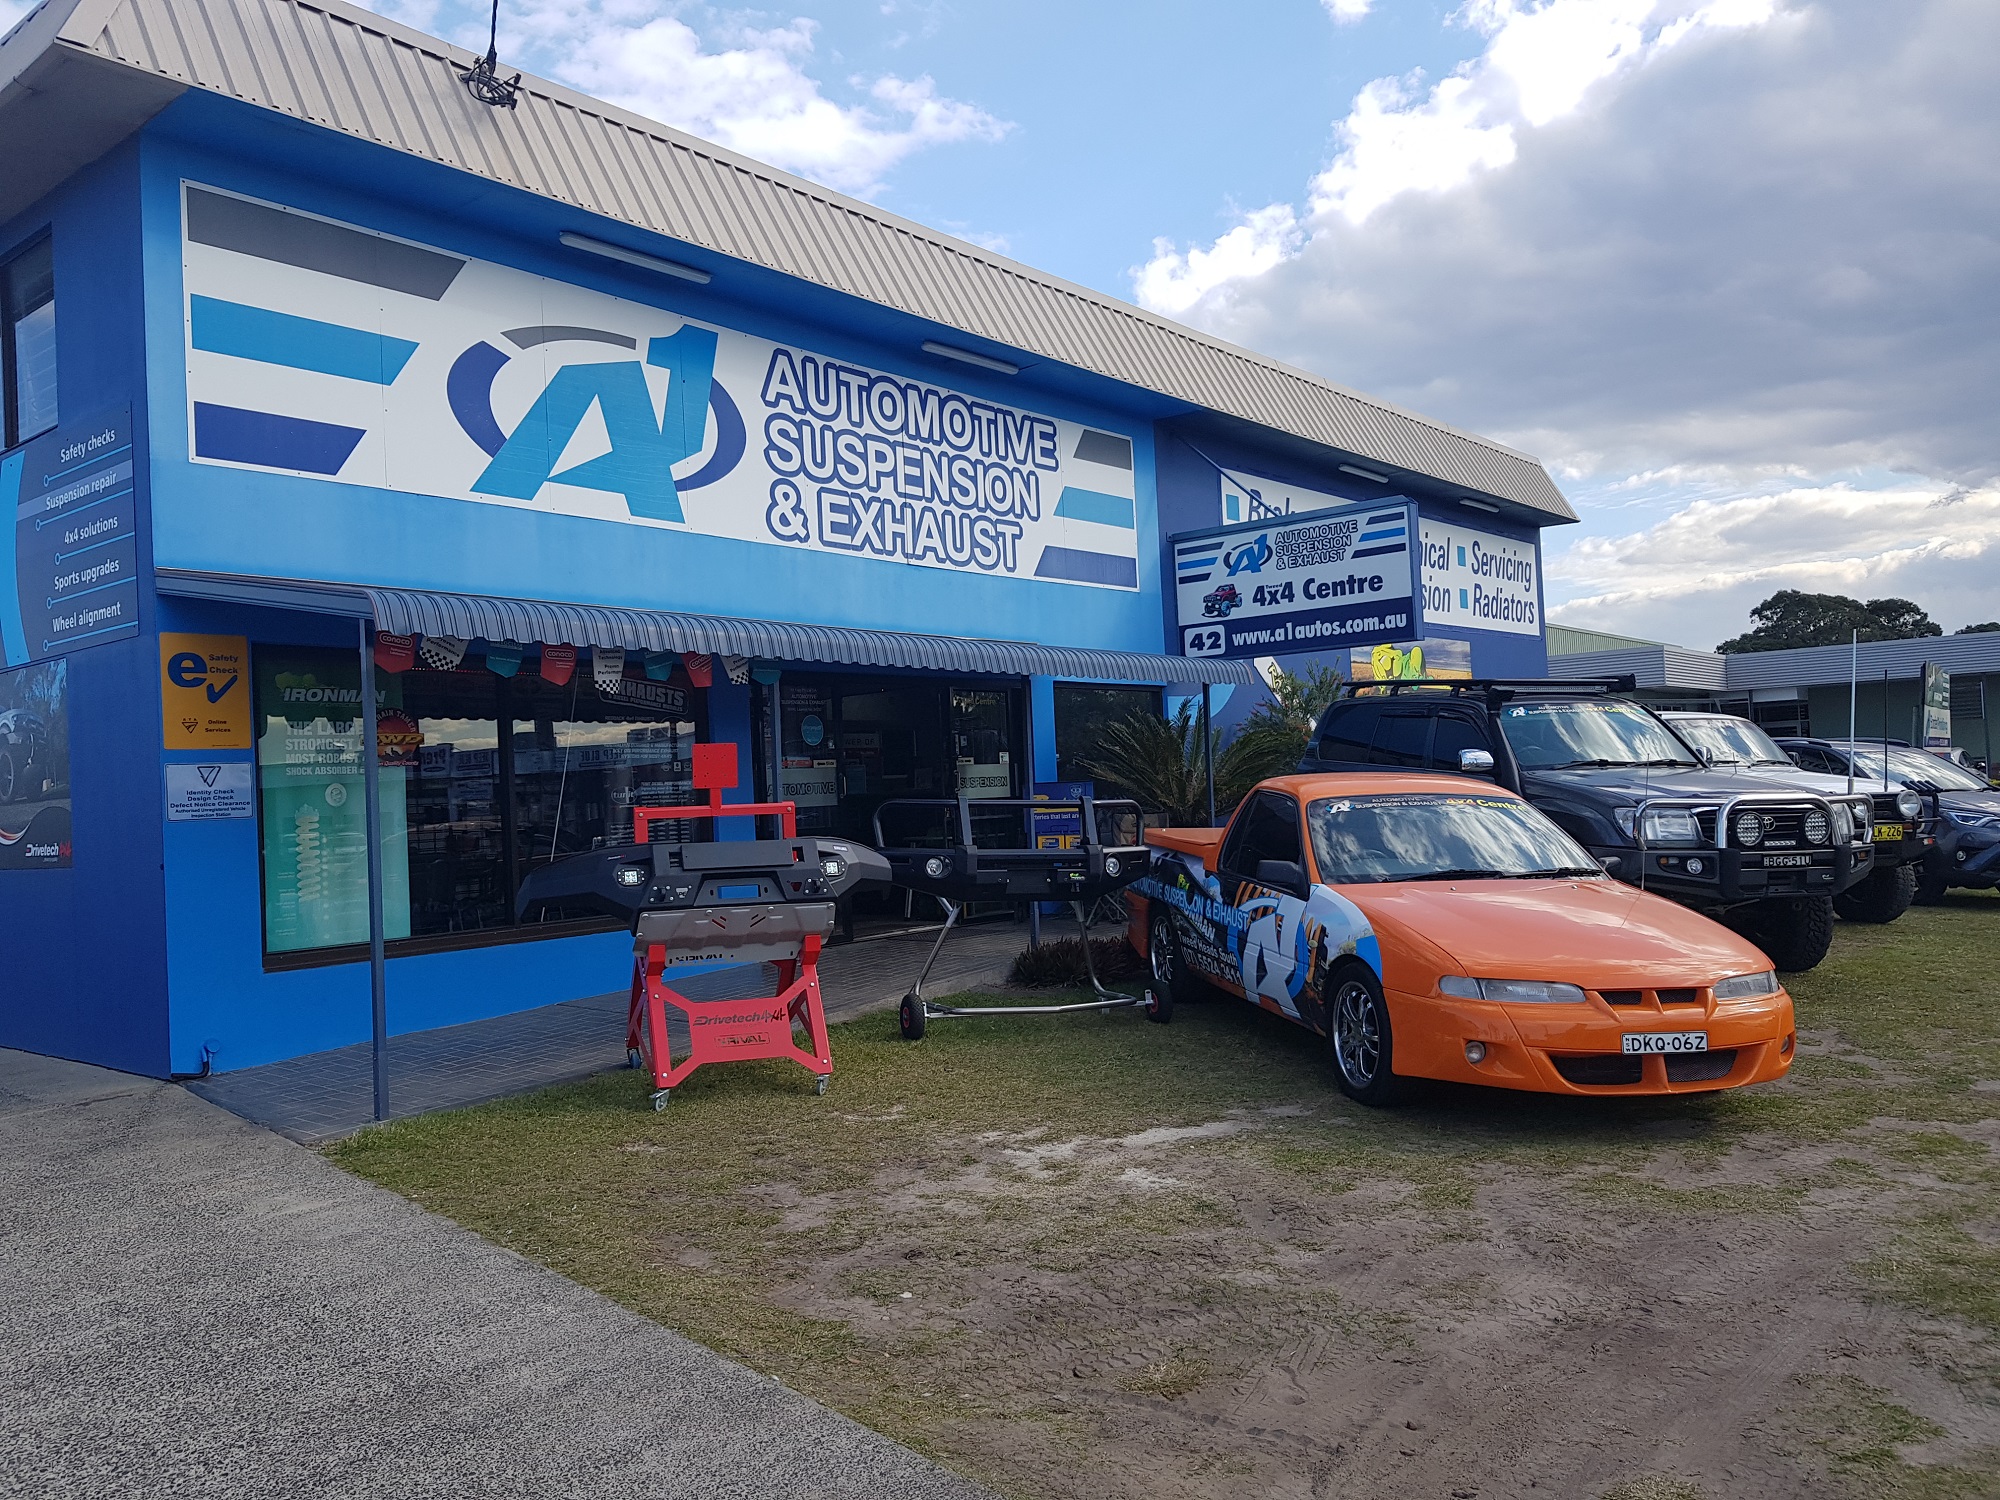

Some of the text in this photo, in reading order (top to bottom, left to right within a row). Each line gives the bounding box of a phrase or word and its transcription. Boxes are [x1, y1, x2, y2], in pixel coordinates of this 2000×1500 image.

[760, 347, 1059, 471] AUTOMOTIVE
[469, 324, 718, 523] A1
[60, 428, 116, 462] Safety checks
[761, 420, 1040, 519] SUSPENSION
[46, 471, 116, 510] Suspension repair
[64, 516, 118, 544] 4x4 solutions
[766, 482, 1021, 571] & EXHAUST
[1275, 520, 1358, 544] AUTOMOTIVE
[1227, 534, 1268, 576] A1
[1276, 535, 1352, 557] SUSPENSION
[1276, 550, 1346, 570] & EXHAUST
[54, 559, 120, 591] Sports upgrades
[1472, 540, 1532, 592] Servicing
[1252, 574, 1384, 606] 4x4 Centre
[1473, 583, 1534, 624] Radiators
[52, 602, 121, 632] Wheel alignment
[1189, 614, 1407, 651] 42 www.a1autos.com.au
[209, 654, 238, 663] Safety
[620, 680, 684, 706] XHAUSTS
[286, 721, 364, 735] THE LARGE
[397, 710, 416, 732] TAMER
[286, 738, 354, 750] STRONGEST
[286, 752, 360, 764] MOST ROBUST
[315, 766, 357, 775] ABSORBER
[960, 776, 1007, 787] SUSPENSION
[767, 782, 836, 796] ATOMOTIVE
[1476, 799, 1526, 810] Centre
[1206, 901, 1212, 918] &
[1178, 931, 1237, 967] Tweed Heads South
